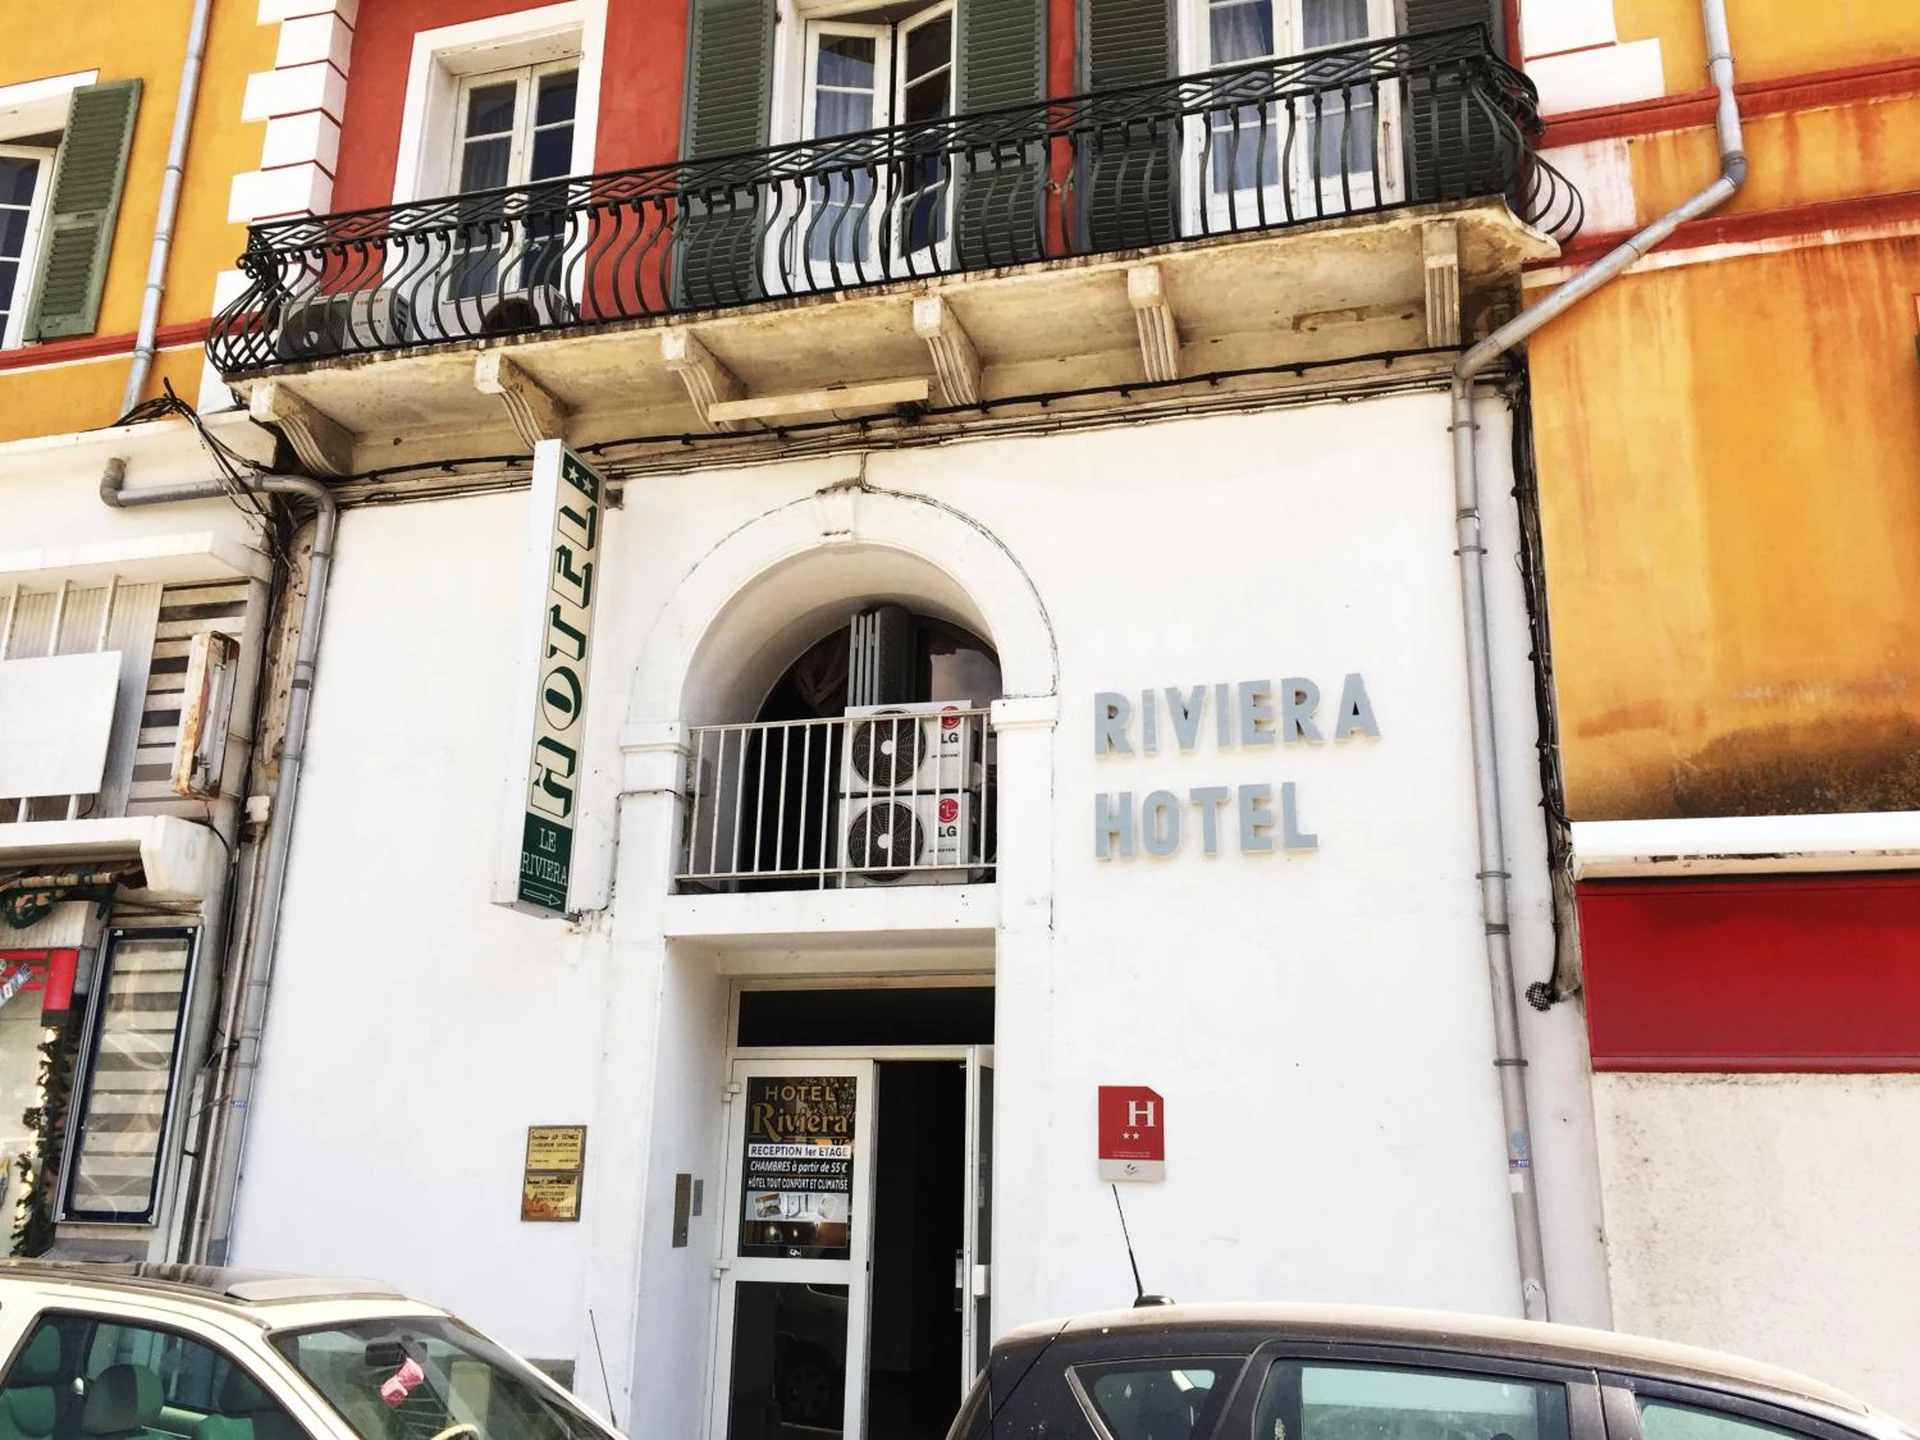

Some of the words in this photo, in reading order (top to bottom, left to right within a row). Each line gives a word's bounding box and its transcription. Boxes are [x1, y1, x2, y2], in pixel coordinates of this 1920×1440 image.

[531, 504, 598, 819] HOTEL
[1094, 672, 1382, 757] RIVIERA
[940, 732, 959, 744] LG
[1095, 781, 1319, 858] HOTEL
[539, 827, 557, 852] LE
[938, 826, 957, 837] LG
[520, 851, 568, 886] RIVIERA
[765, 1085, 835, 1101] HOTEL
[1126, 1100, 1156, 1127] H
[750, 1146, 802, 1156] RECEPTION
[805, 1147, 816, 1156] 1er
[750, 1161, 791, 1172] CHAMBRES
[797, 1162, 820, 1174] partir
[820, 1162, 829, 1172] de
[782, 1178, 809, 1189] CONFORT
